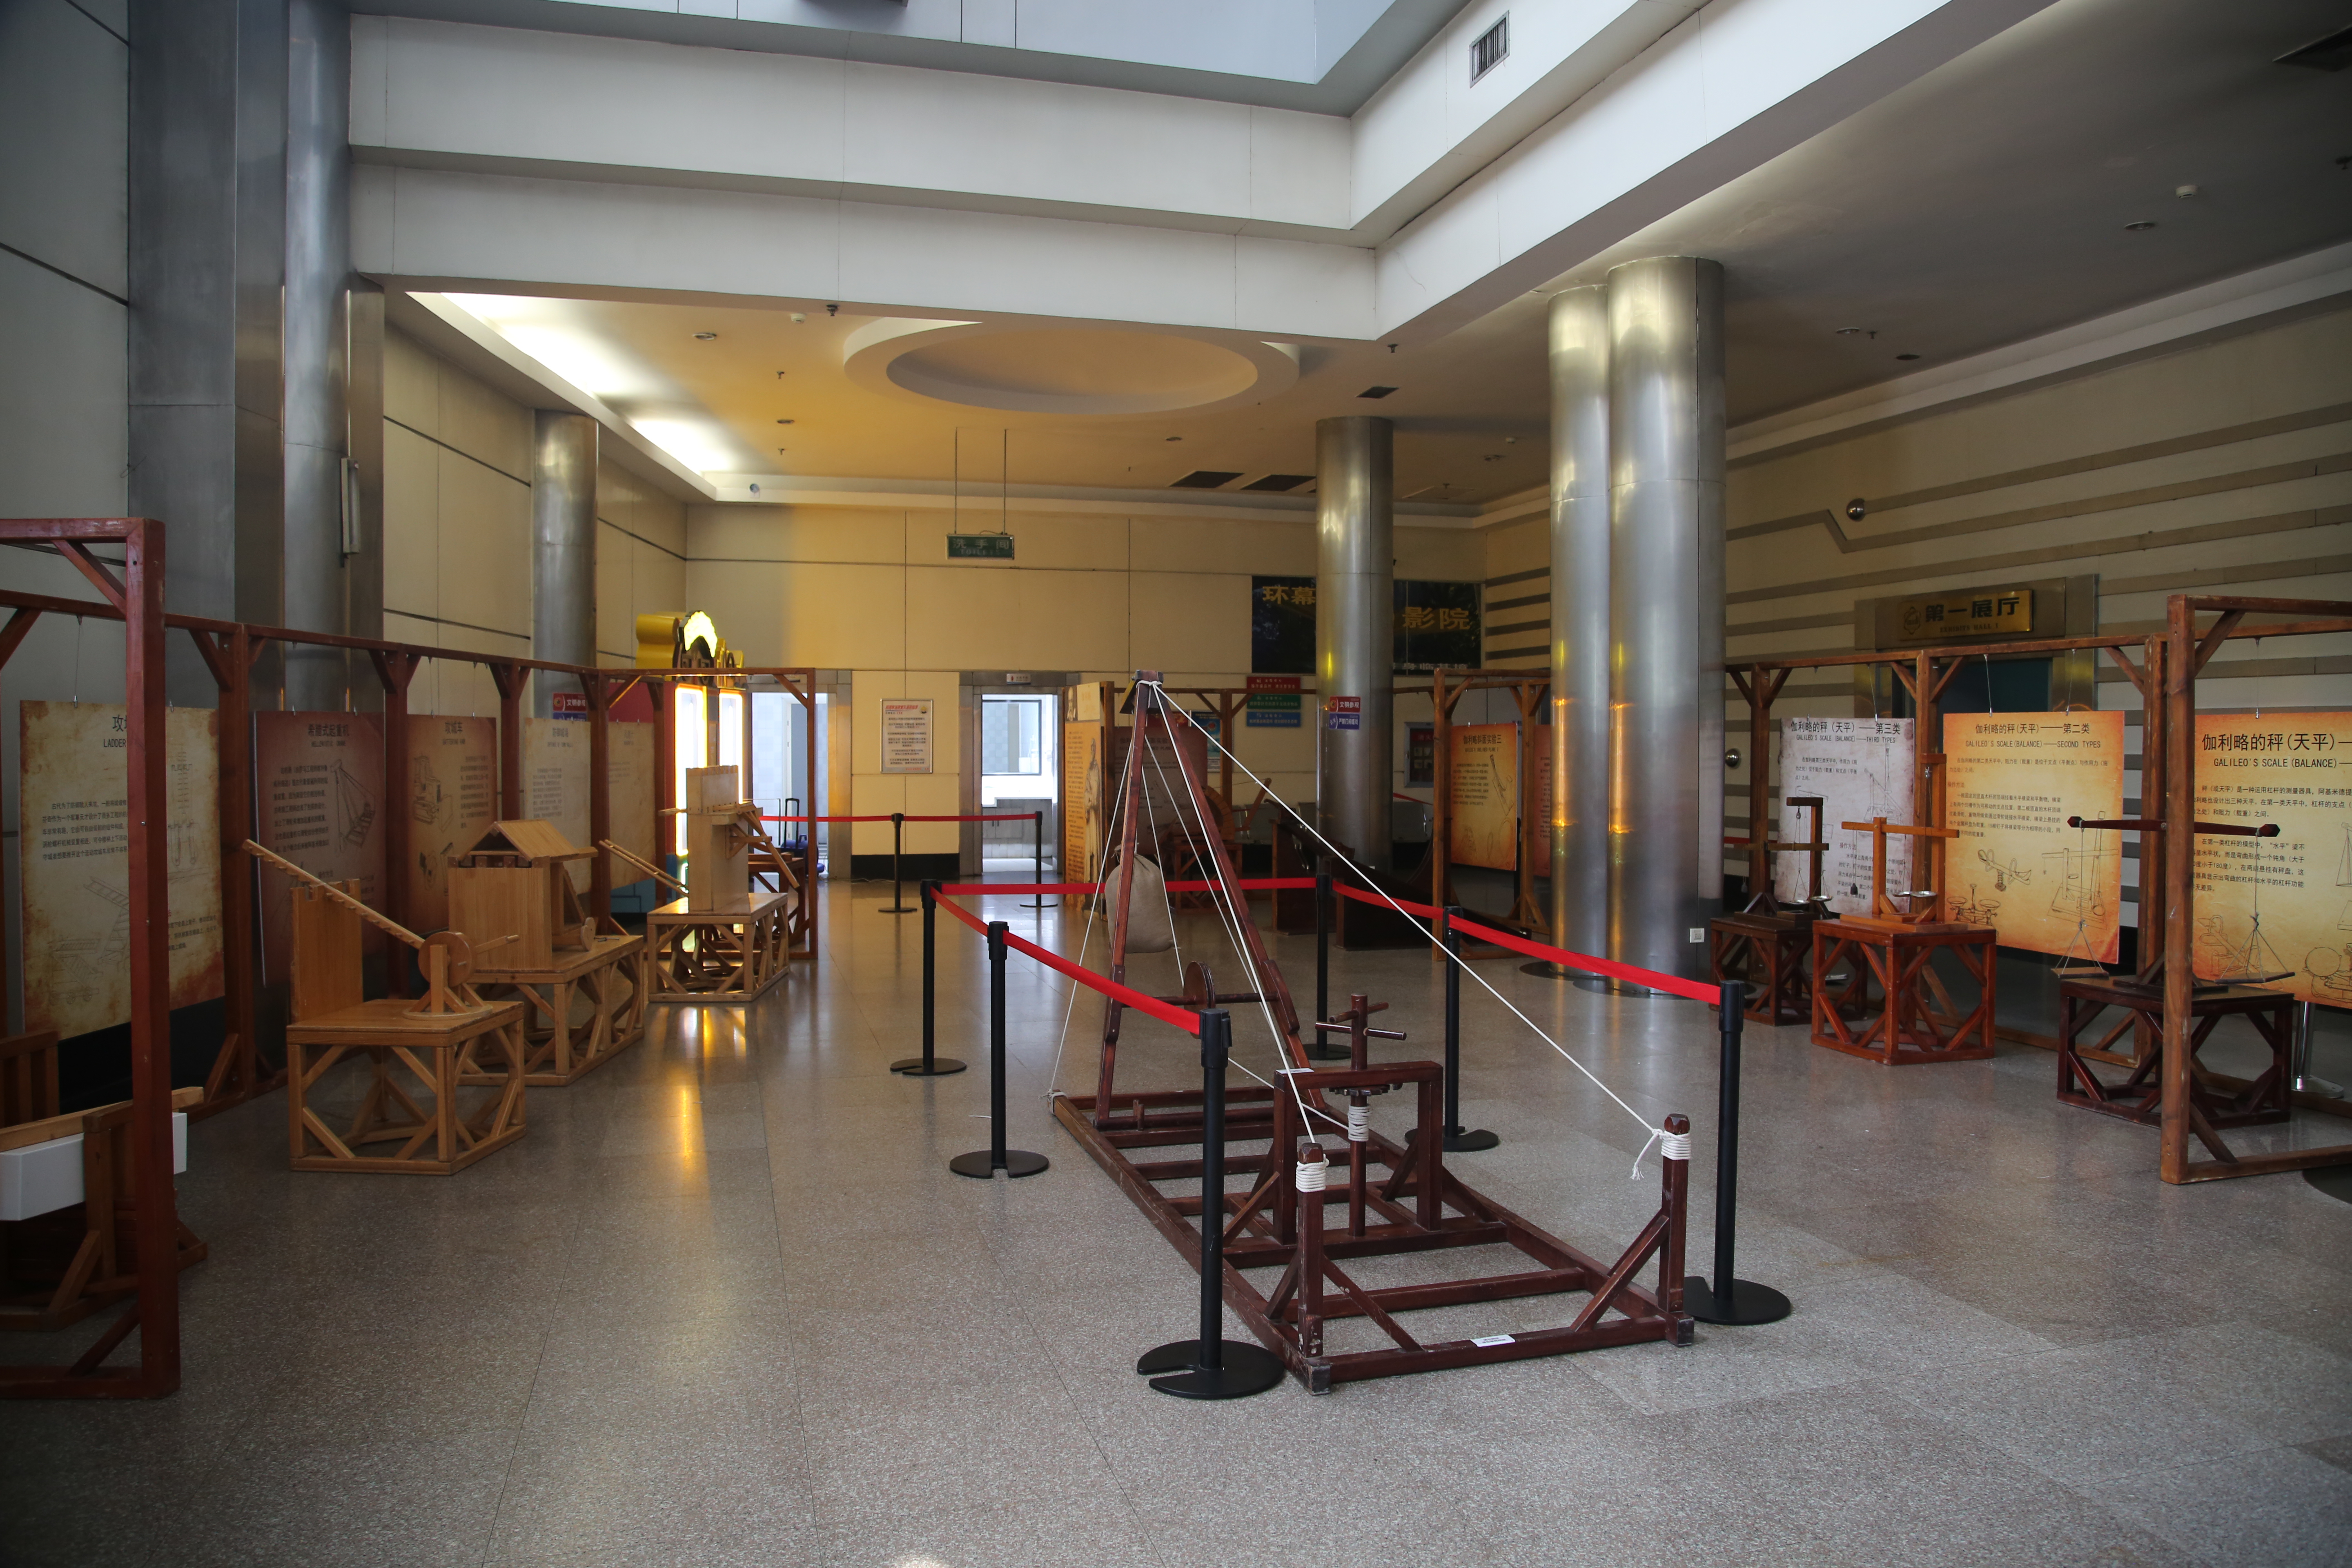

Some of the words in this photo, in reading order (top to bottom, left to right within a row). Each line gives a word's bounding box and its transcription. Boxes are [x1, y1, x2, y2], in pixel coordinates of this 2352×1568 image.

[953, 539, 1009, 549] 洗手间
[1262, 586, 1316, 605] 环幕
[1925, 597, 2020, 622] 第一展厅
[1402, 606, 1471, 630] 影院
[104, 739, 127, 748] LADDER
[2214, 758, 2258, 767] GALILEO'S
[2262, 758, 2288, 768] SCALE
[2194, 797, 2352, 808] 利略也设计出三种天平。在第一类天平中，杠杆的支点（
[2194, 808, 2270, 818] 之处）和阻力（载重）之间。
[2194, 849, 2305, 863] 呈水平状，而是弯曲形成一个钝角（大于
[2194, 872, 2304, 888] 器具显示出弯曲的杠杆和水平的杠杆功能
